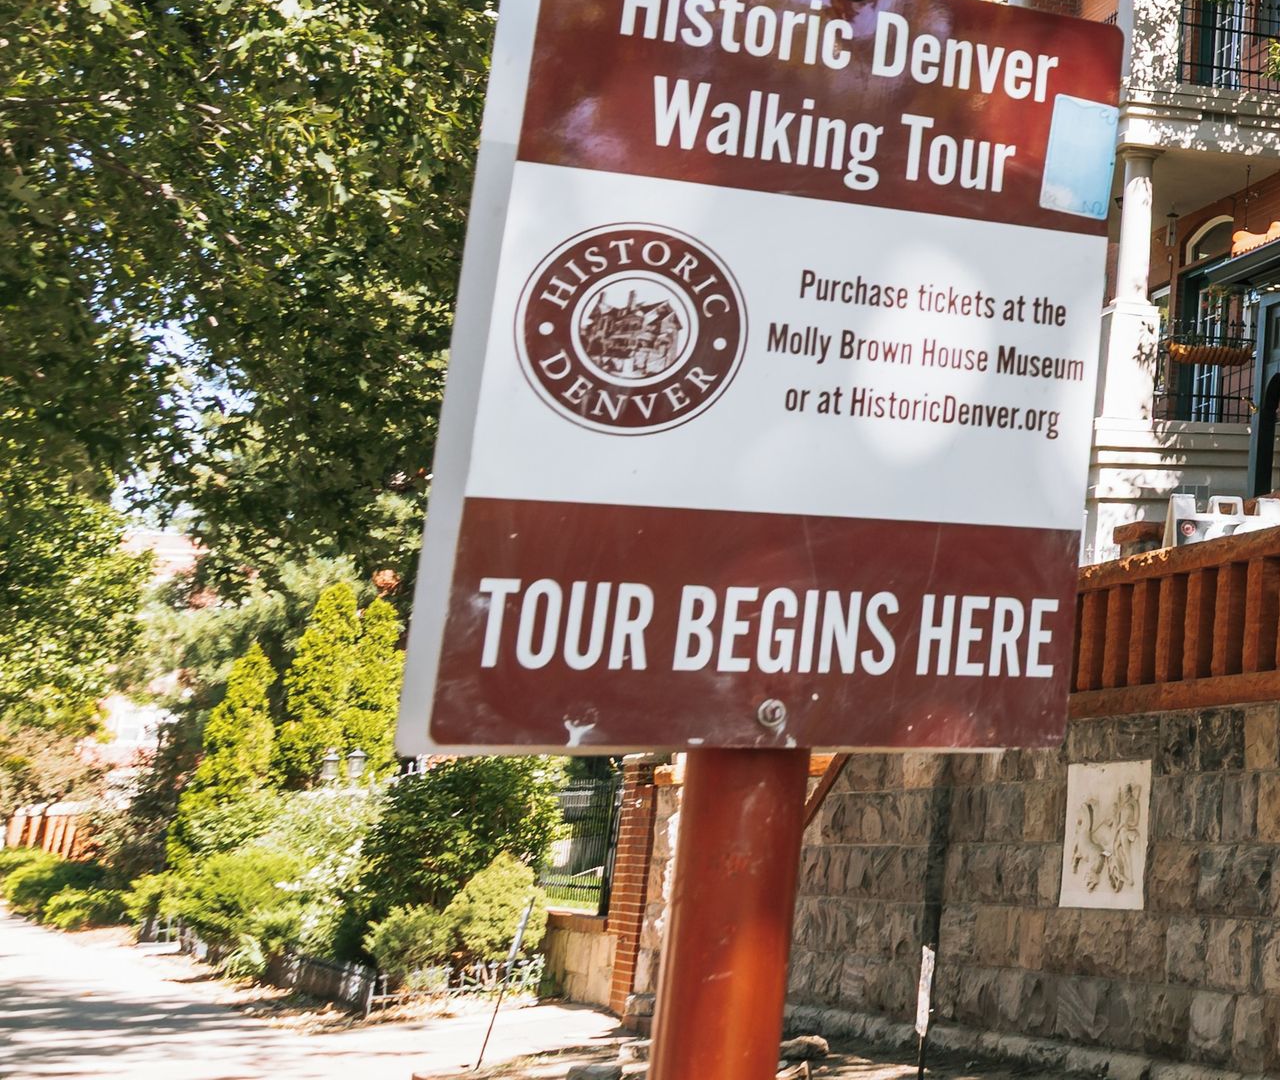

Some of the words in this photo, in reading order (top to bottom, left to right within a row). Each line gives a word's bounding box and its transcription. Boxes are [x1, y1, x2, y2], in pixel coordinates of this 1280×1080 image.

[871, 10, 1059, 103] Denver
[652, 75, 884, 191] Walking
[900, 113, 1017, 193] Tour
[540, 237, 731, 319] HISTORIC
[799, 269, 909, 309] Purchase
[918, 283, 996, 319] tickets
[1002, 295, 1026, 322] at
[1033, 297, 1067, 327] the
[539, 348, 718, 421] DENVER
[766, 322, 832, 365] Molly
[839, 329, 913, 366] Brown
[921, 338, 989, 372] House
[996, 345, 1085, 382] Museum
[784, 387, 811, 413] or
[816, 386, 843, 415] at
[849, 387, 1061, 440] HistoricDenver.org
[479, 578, 655, 671] TOUR
[671, 584, 900, 677] BEGINS
[914, 593, 1059, 678] HERE
